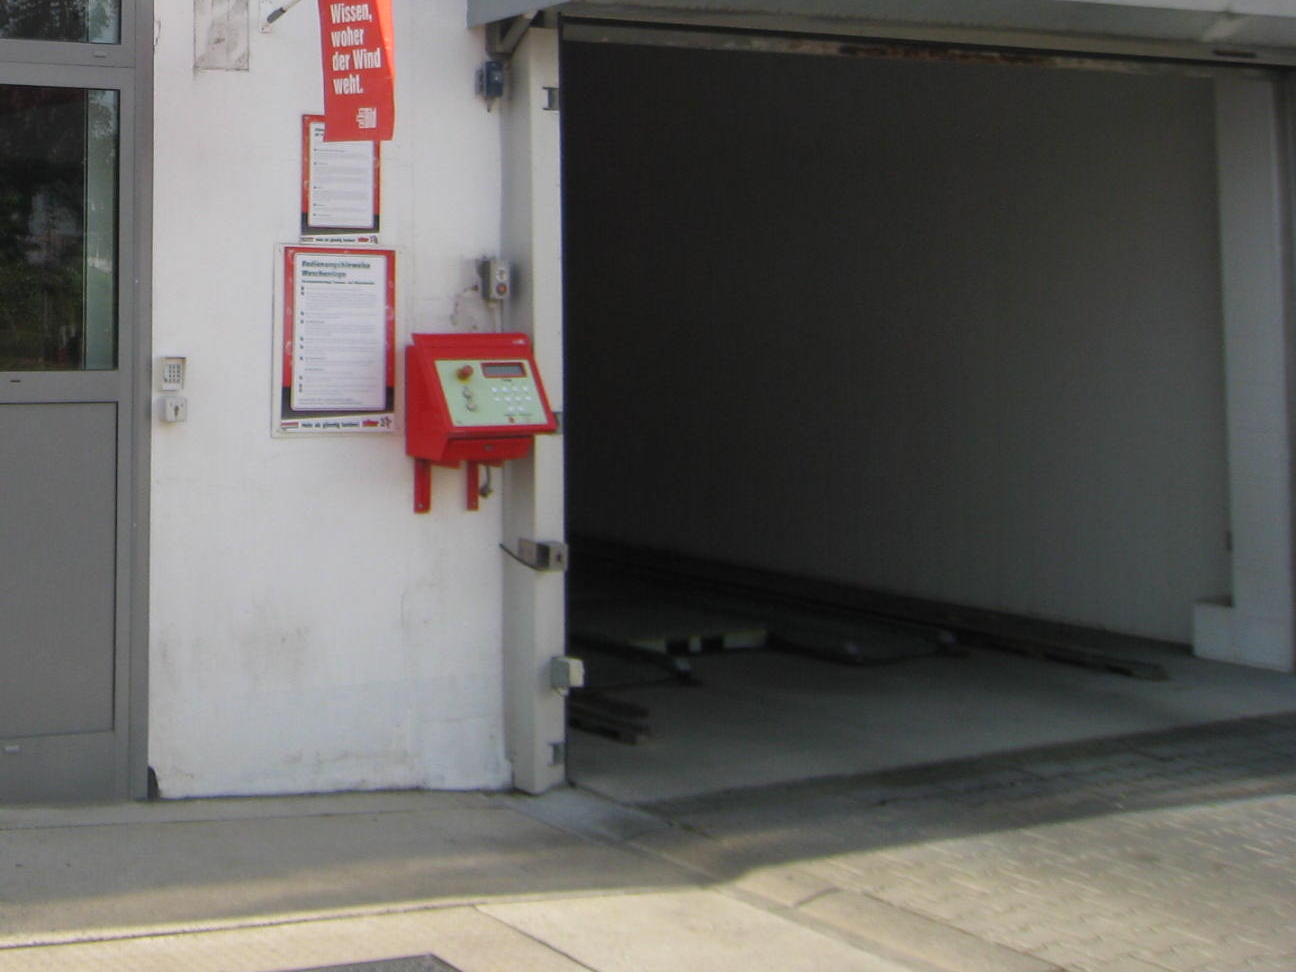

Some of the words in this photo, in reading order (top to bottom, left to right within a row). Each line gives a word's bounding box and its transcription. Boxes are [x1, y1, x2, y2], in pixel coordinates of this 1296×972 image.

[330, 3, 373, 24] Wissen,
[331, 26, 364, 48] woher
[332, 51, 350, 71] der
[353, 48, 381, 70] Wind
[333, 74, 364, 95] weht.
